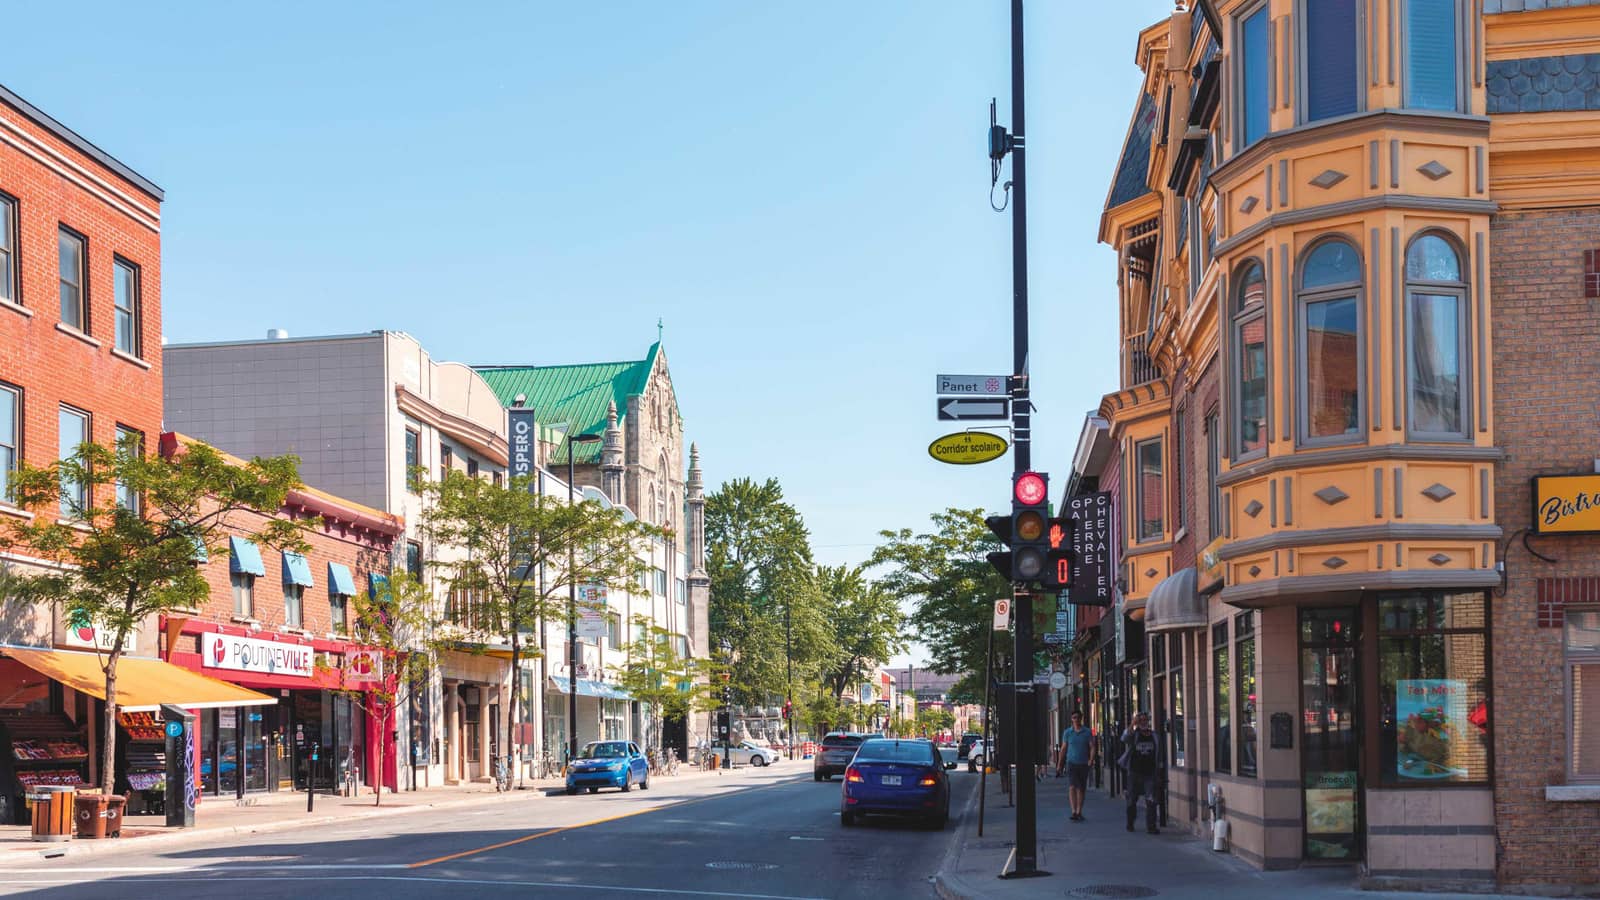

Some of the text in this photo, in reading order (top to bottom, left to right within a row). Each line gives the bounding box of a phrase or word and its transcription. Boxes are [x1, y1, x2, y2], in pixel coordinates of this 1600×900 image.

[942, 381, 978, 392] Panet
[935, 441, 1001, 455] Corridor scolaire
[1084, 498, 1094, 564] PIERRE
[1096, 496, 1107, 597] CHEVALIER
[233, 642, 309, 671] POUTINEVILLE
